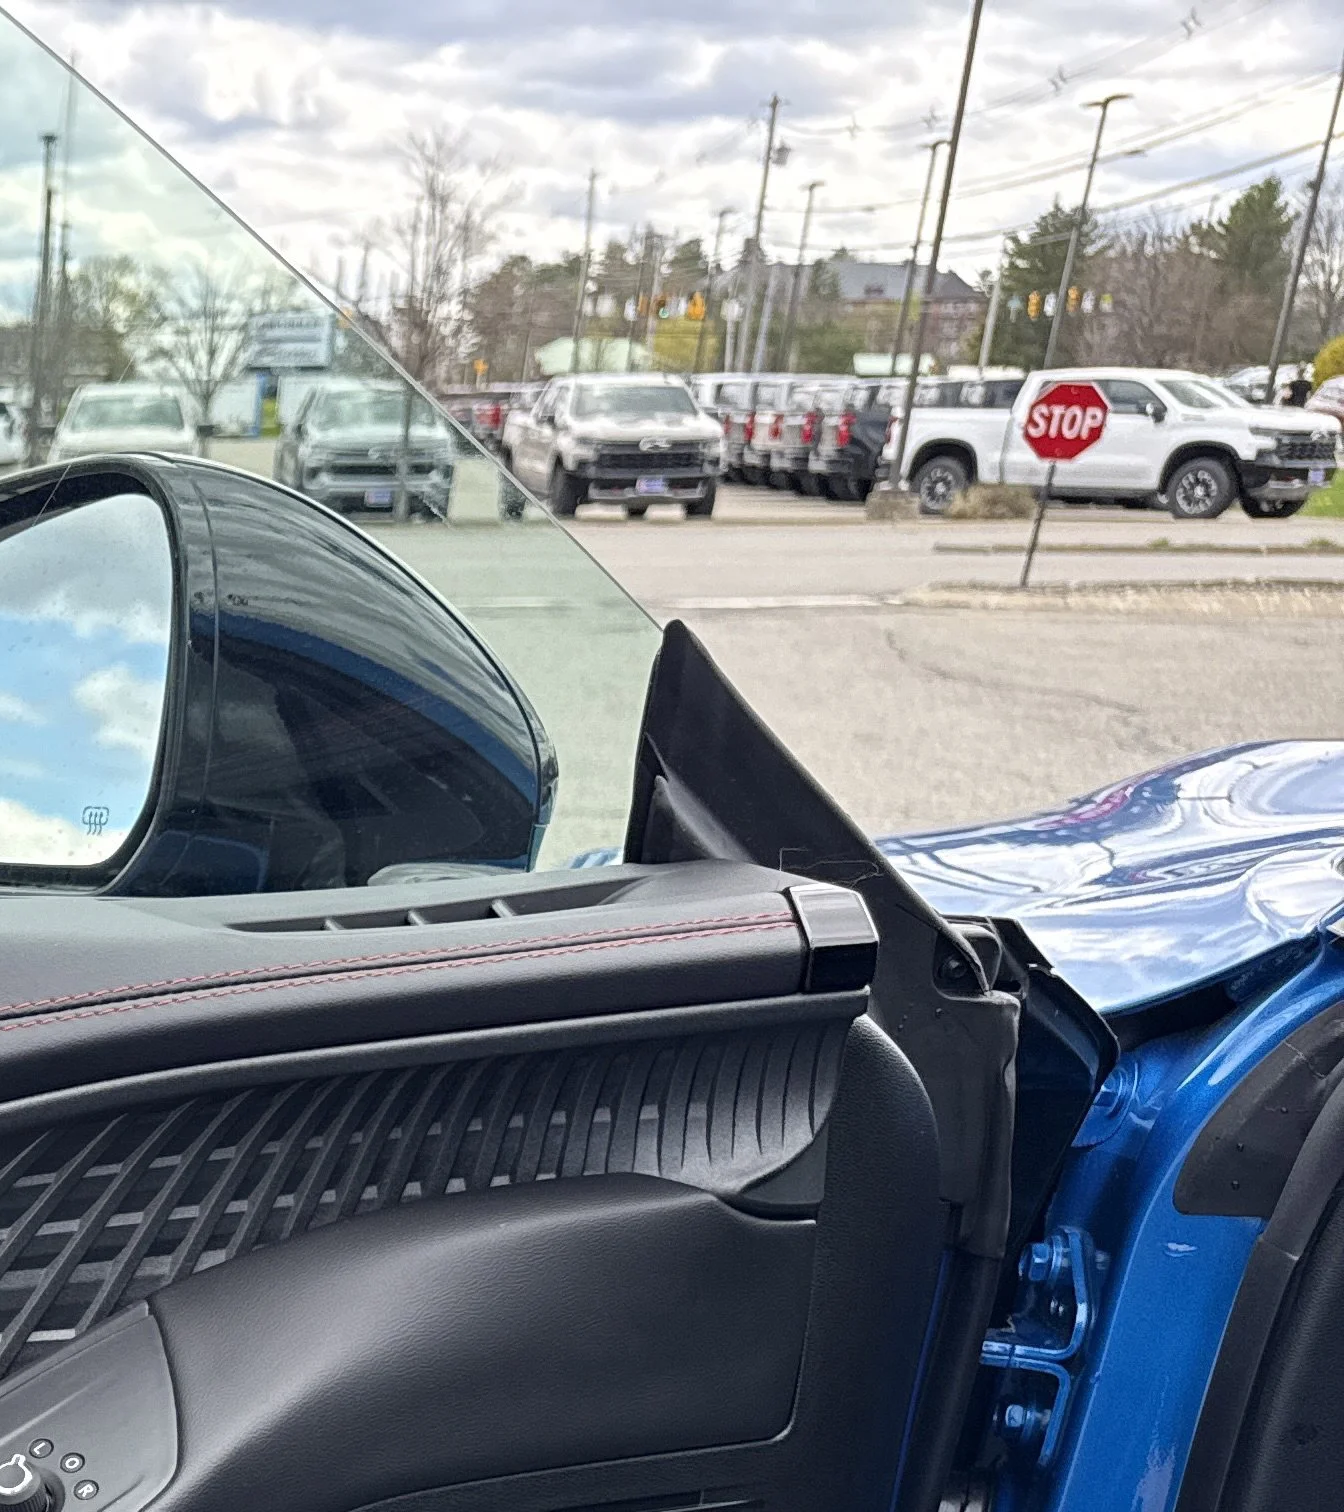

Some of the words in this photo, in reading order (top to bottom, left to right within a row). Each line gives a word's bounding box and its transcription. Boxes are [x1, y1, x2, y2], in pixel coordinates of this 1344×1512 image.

[1026, 403, 1104, 440] STOP
[33, 1442, 46, 1455] L
[78, 1483, 94, 1498] R
